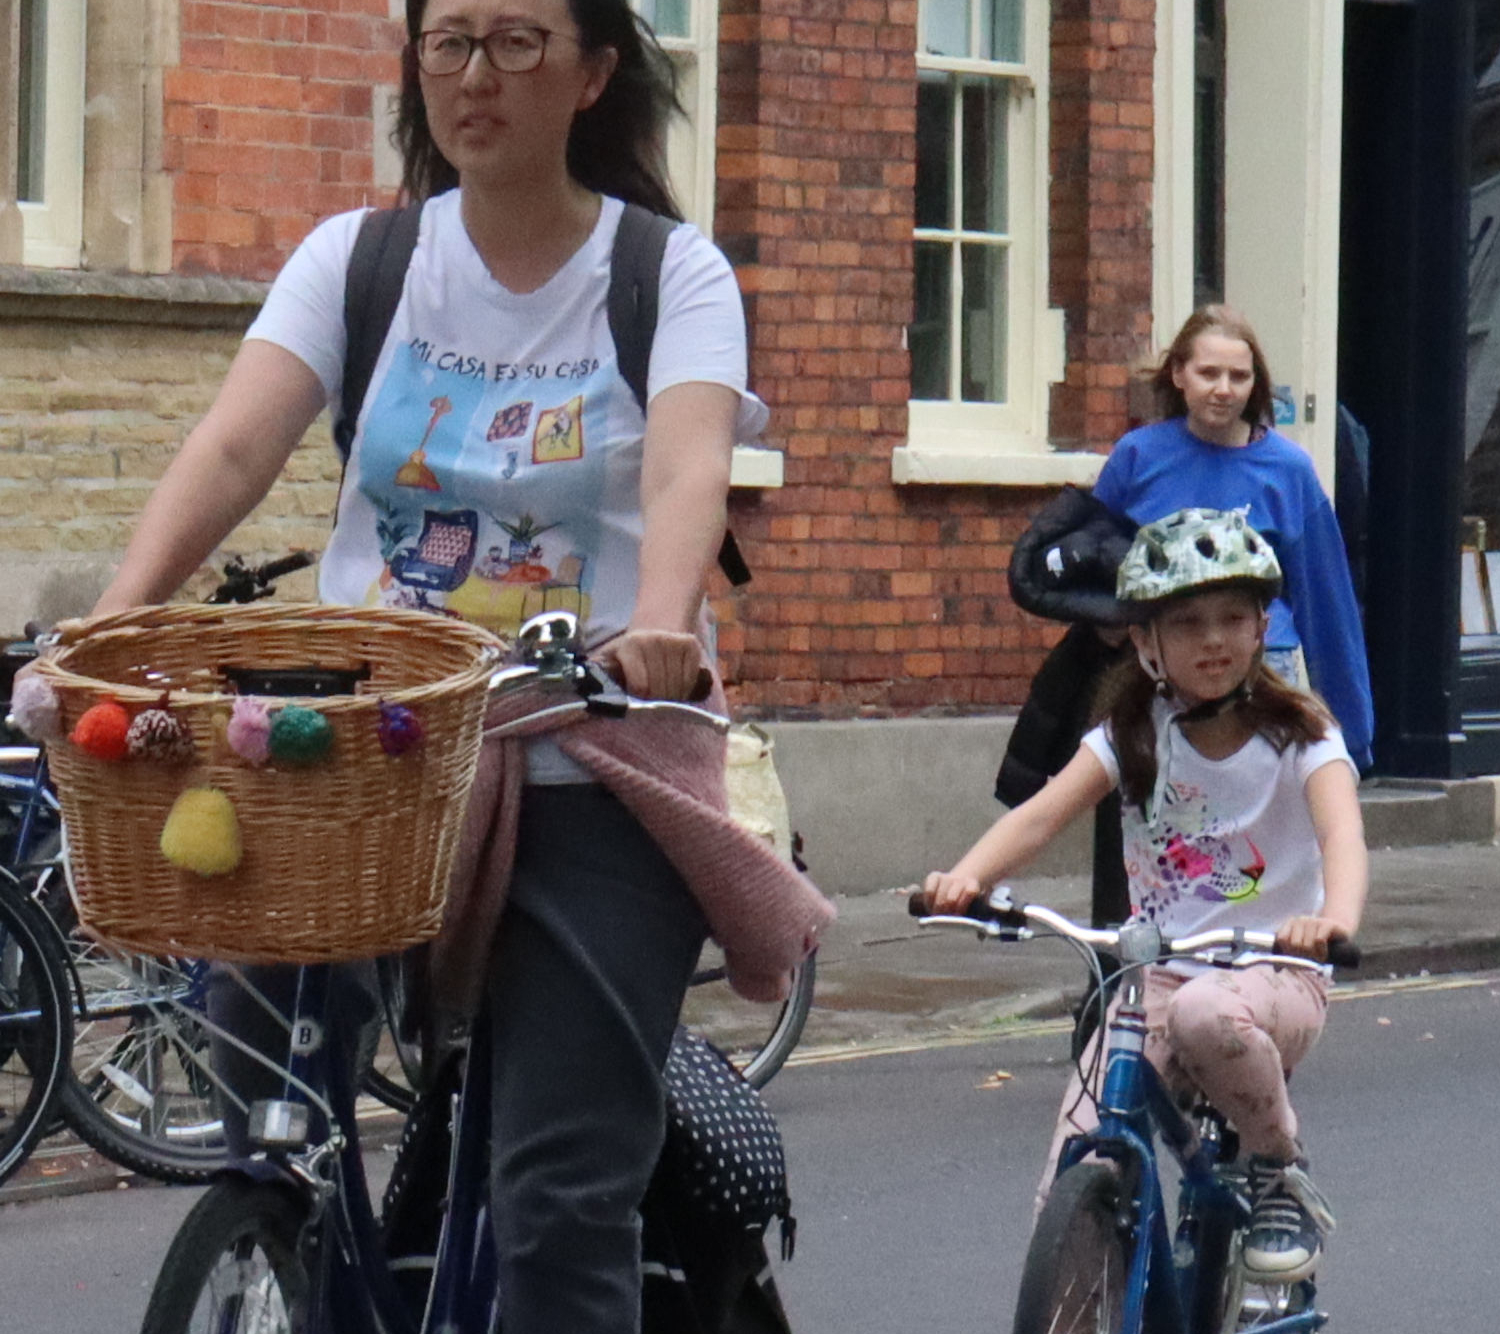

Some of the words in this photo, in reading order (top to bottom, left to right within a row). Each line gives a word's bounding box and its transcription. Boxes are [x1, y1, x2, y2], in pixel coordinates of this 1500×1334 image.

[437, 352, 486, 381] CASA
[494, 363, 518, 383] ES
[523, 363, 547, 380] SU
[555, 358, 600, 380] CASA
